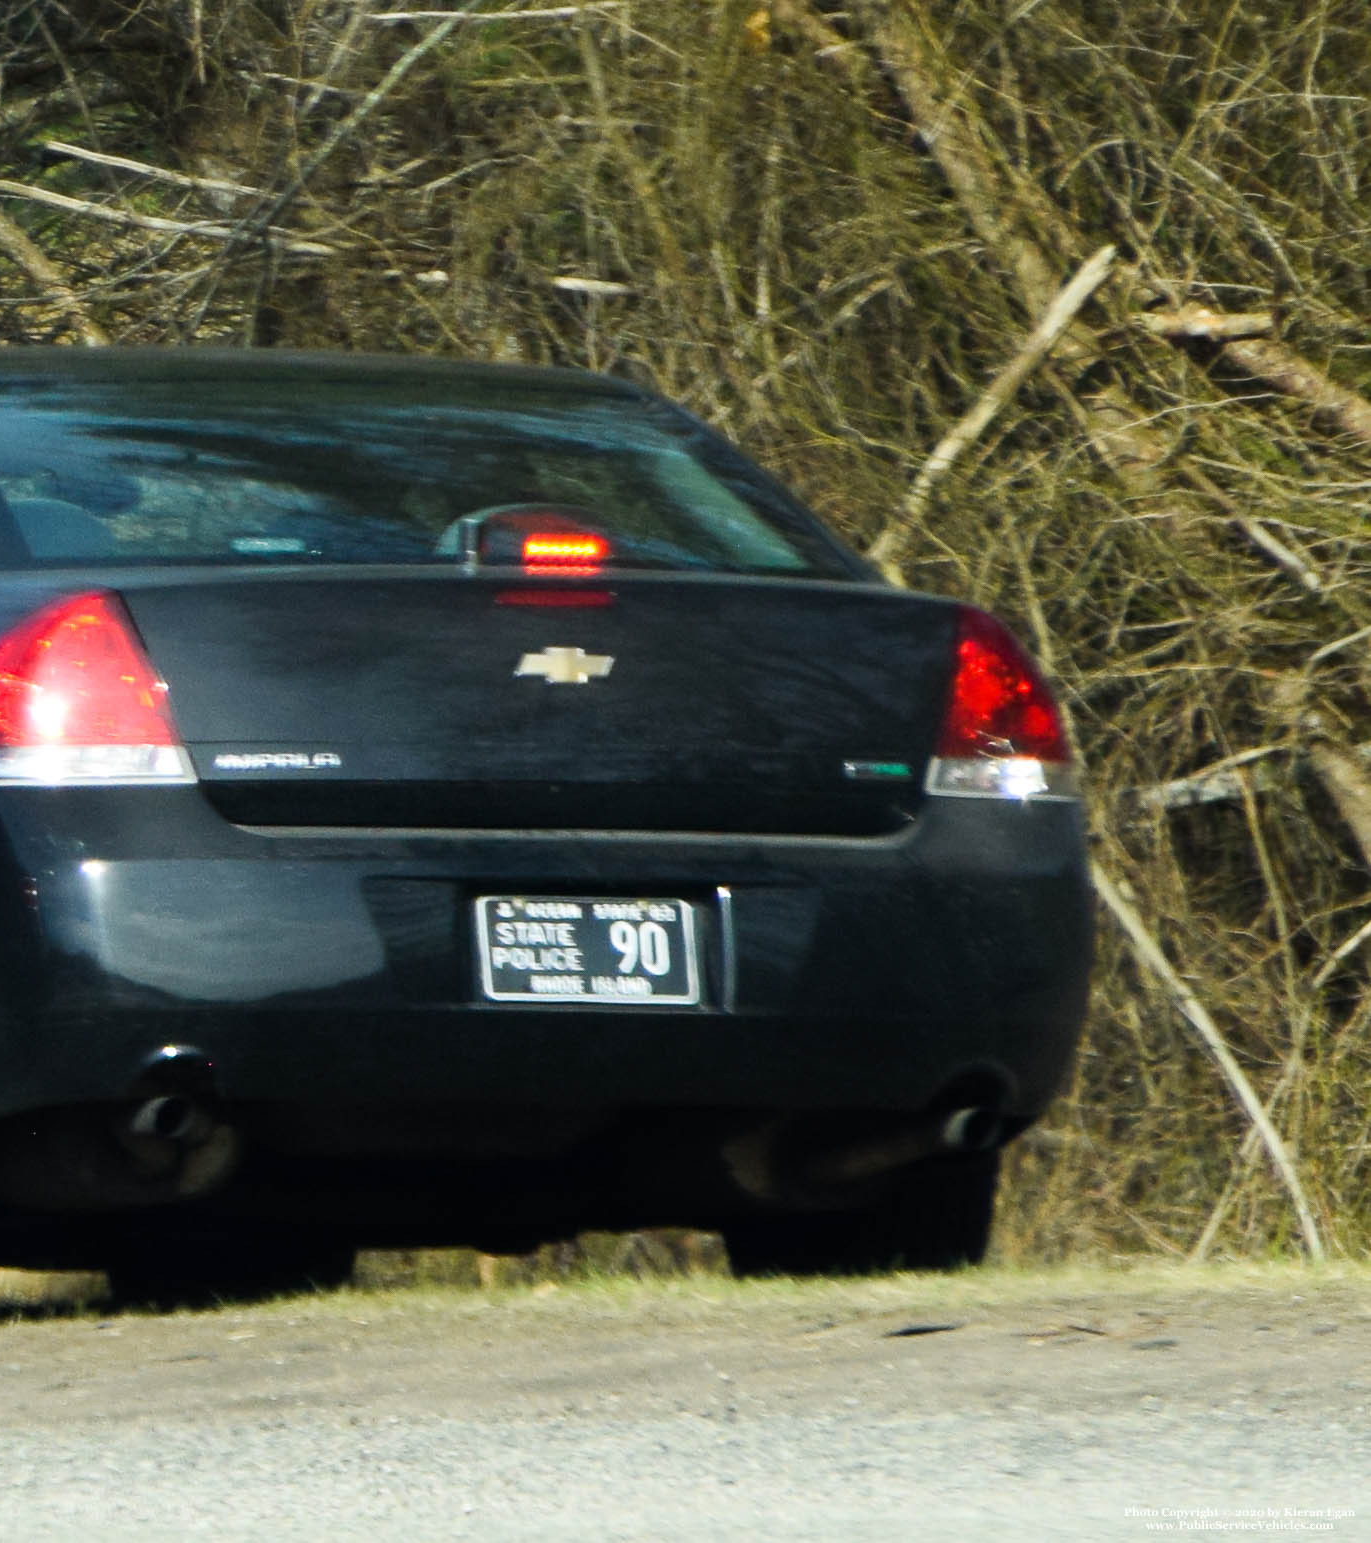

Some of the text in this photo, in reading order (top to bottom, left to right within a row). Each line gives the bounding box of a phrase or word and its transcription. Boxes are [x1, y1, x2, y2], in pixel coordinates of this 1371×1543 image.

[494, 922, 577, 947] STATE
[490, 947, 585, 971] POLICE
[609, 920, 670, 976] 90
